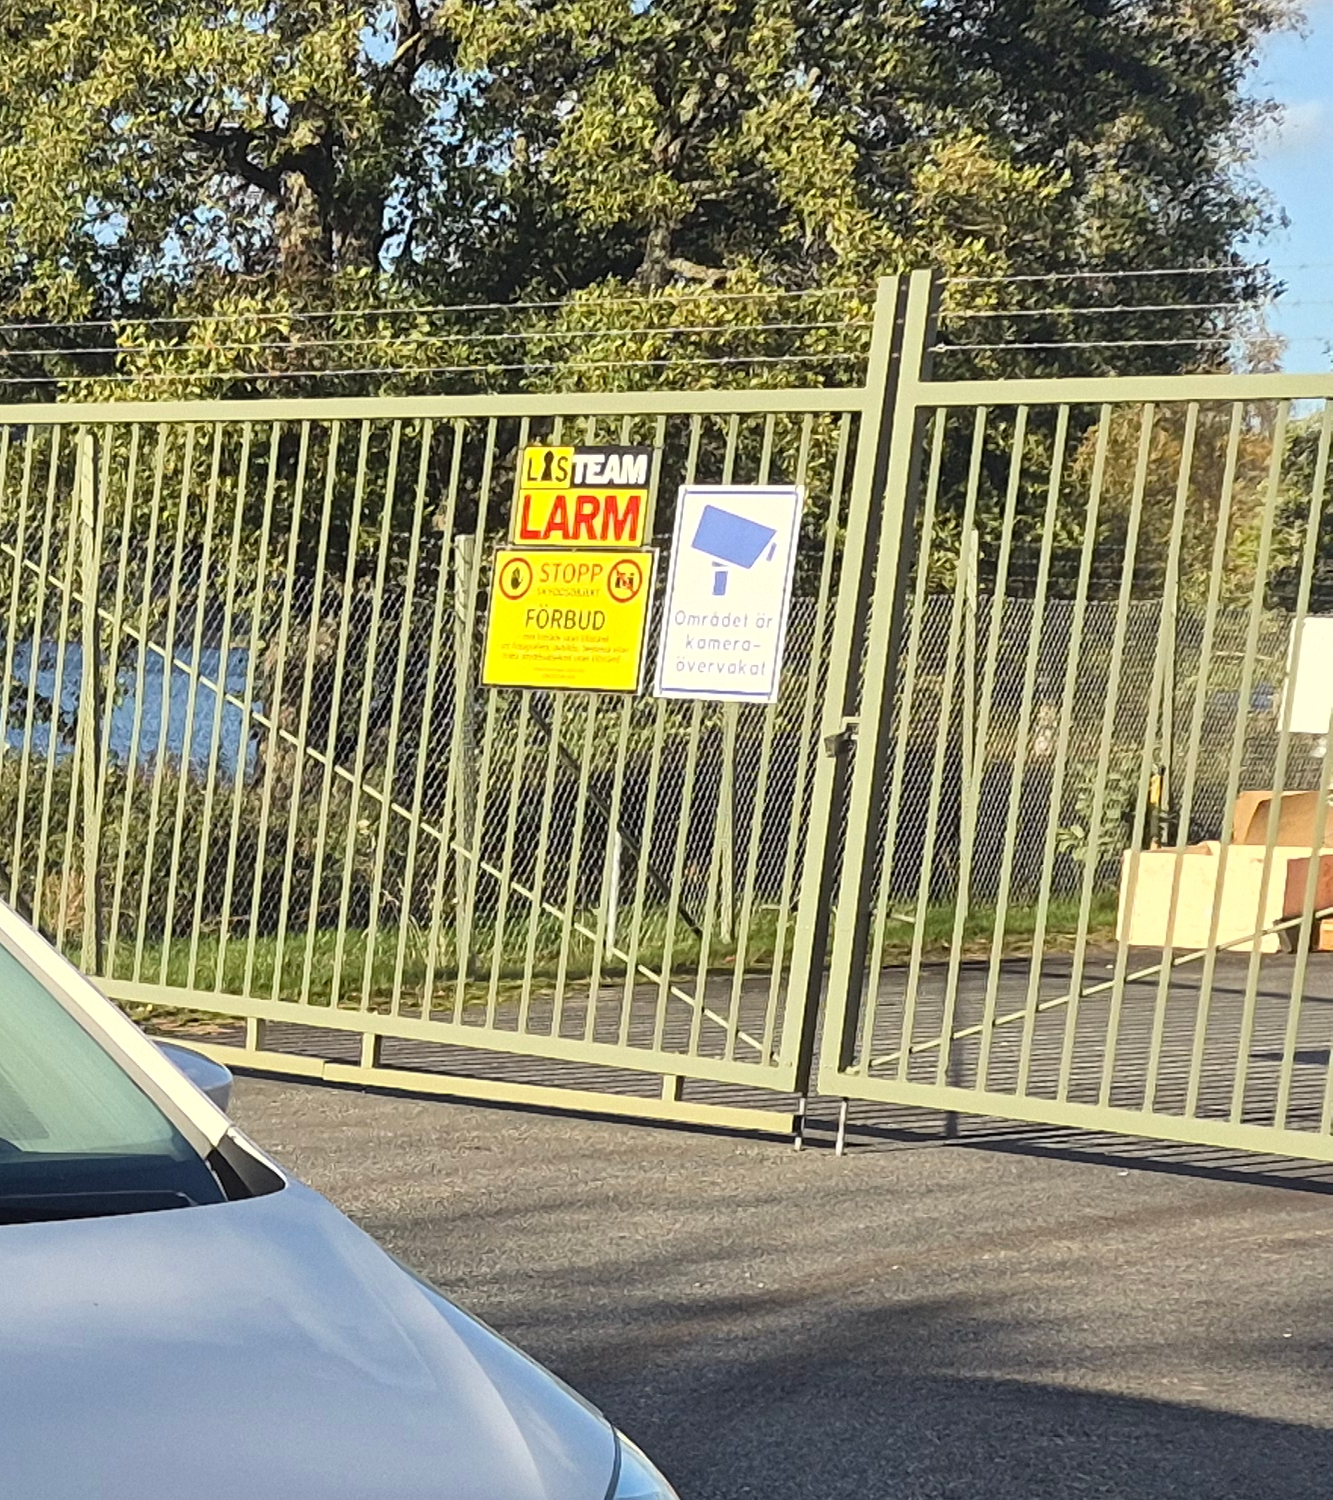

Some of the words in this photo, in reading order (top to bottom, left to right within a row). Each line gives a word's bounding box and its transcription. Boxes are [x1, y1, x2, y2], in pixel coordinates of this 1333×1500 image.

[572, 453, 648, 484] TEAM
[520, 494, 641, 541] LARM
[539, 562, 604, 584] STOPP
[525, 604, 606, 631] FÖRBUD
[674, 610, 748, 628] Området
[756, 612, 773, 629] är
[685, 634, 761, 652] kamera-
[676, 655, 766, 676] övervakat
